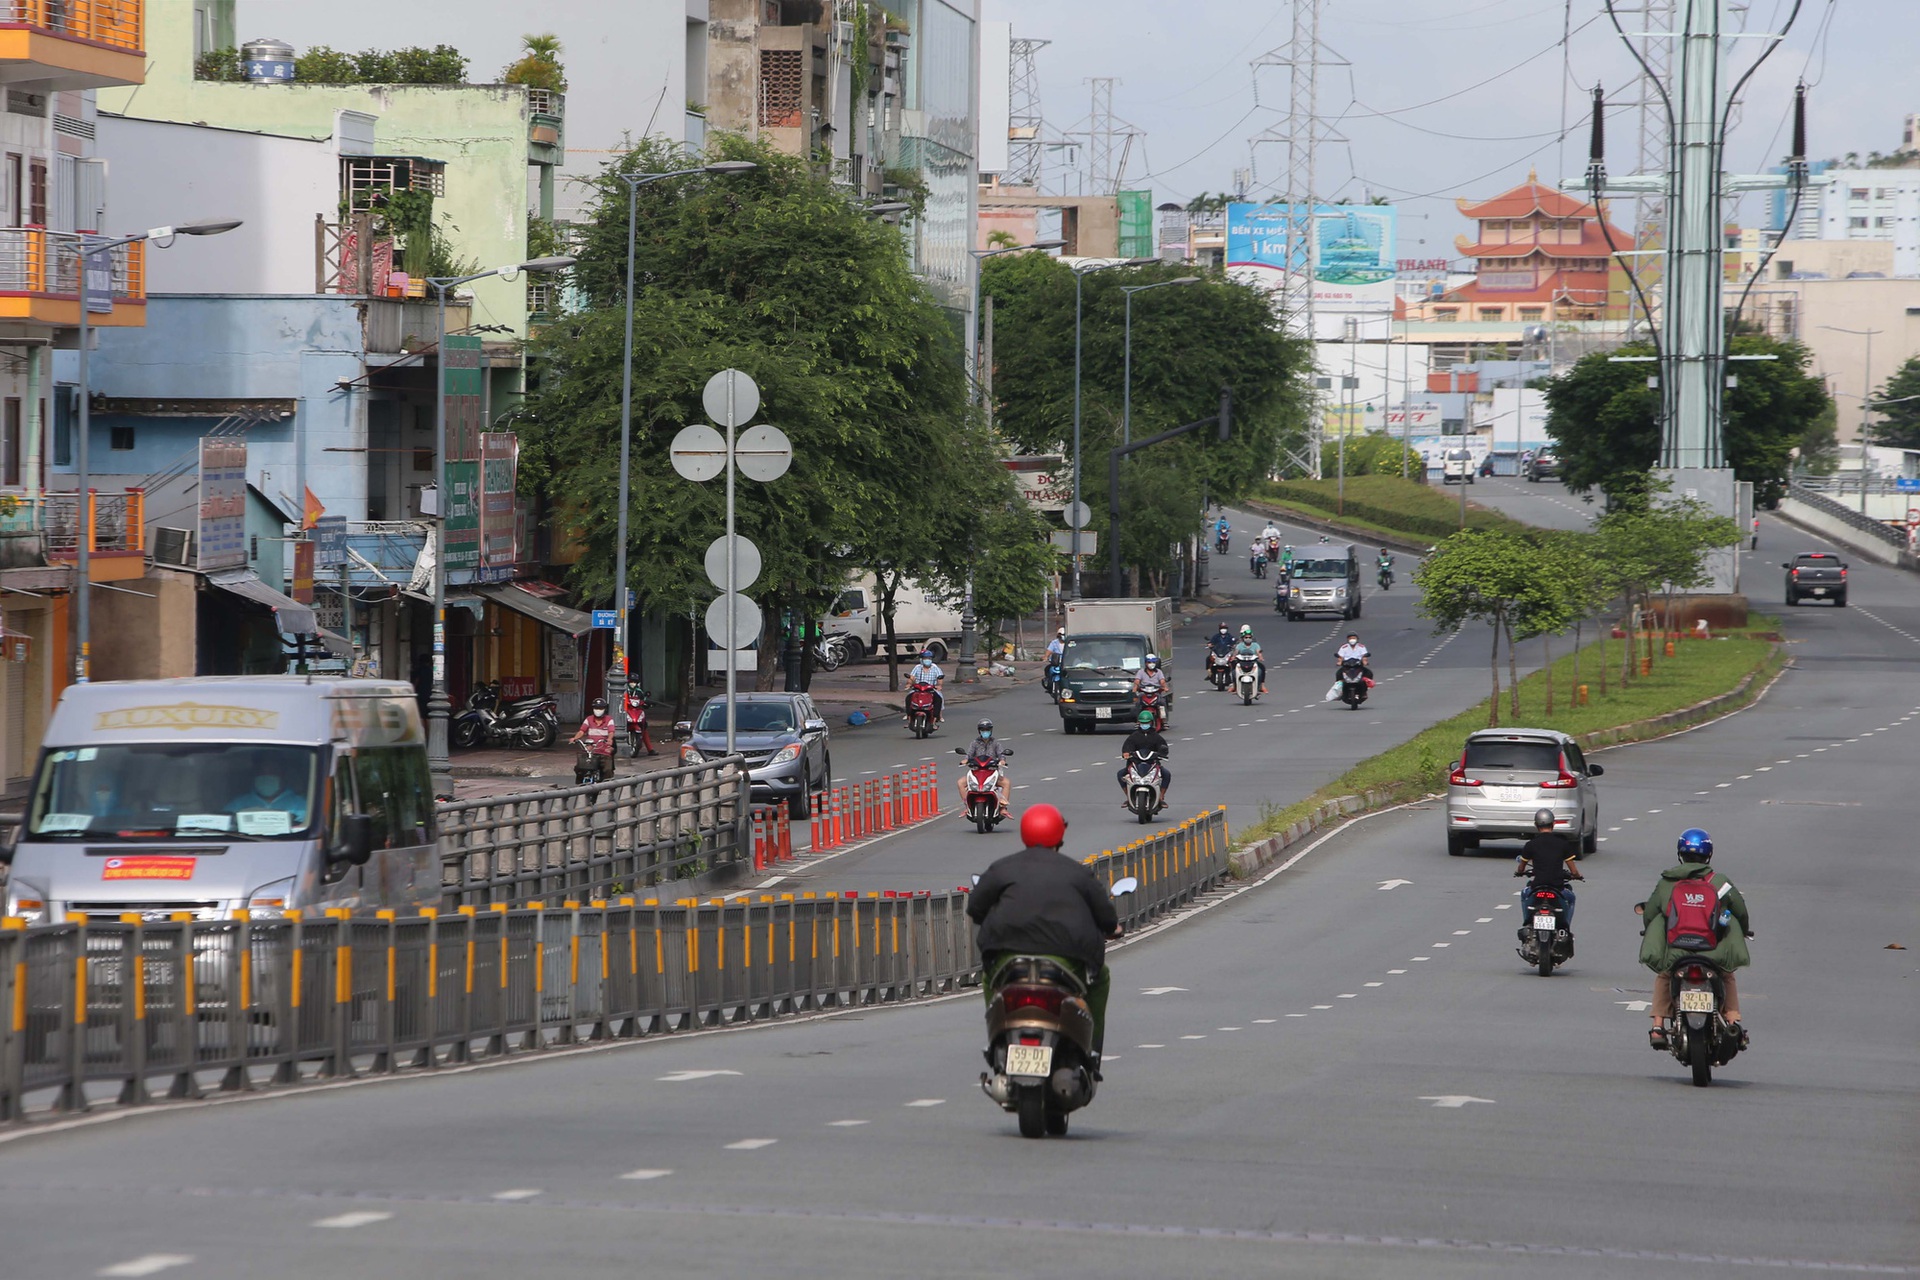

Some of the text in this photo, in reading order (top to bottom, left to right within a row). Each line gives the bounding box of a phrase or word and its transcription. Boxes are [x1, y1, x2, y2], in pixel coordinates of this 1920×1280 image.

[1262, 239, 1287, 254] km
[522, 683, 534, 697] XE
[100, 706, 276, 728] LUXURY
[1014, 1047, 1045, 1061] 59-D1
[1009, 1060, 1049, 1074] 127.25
